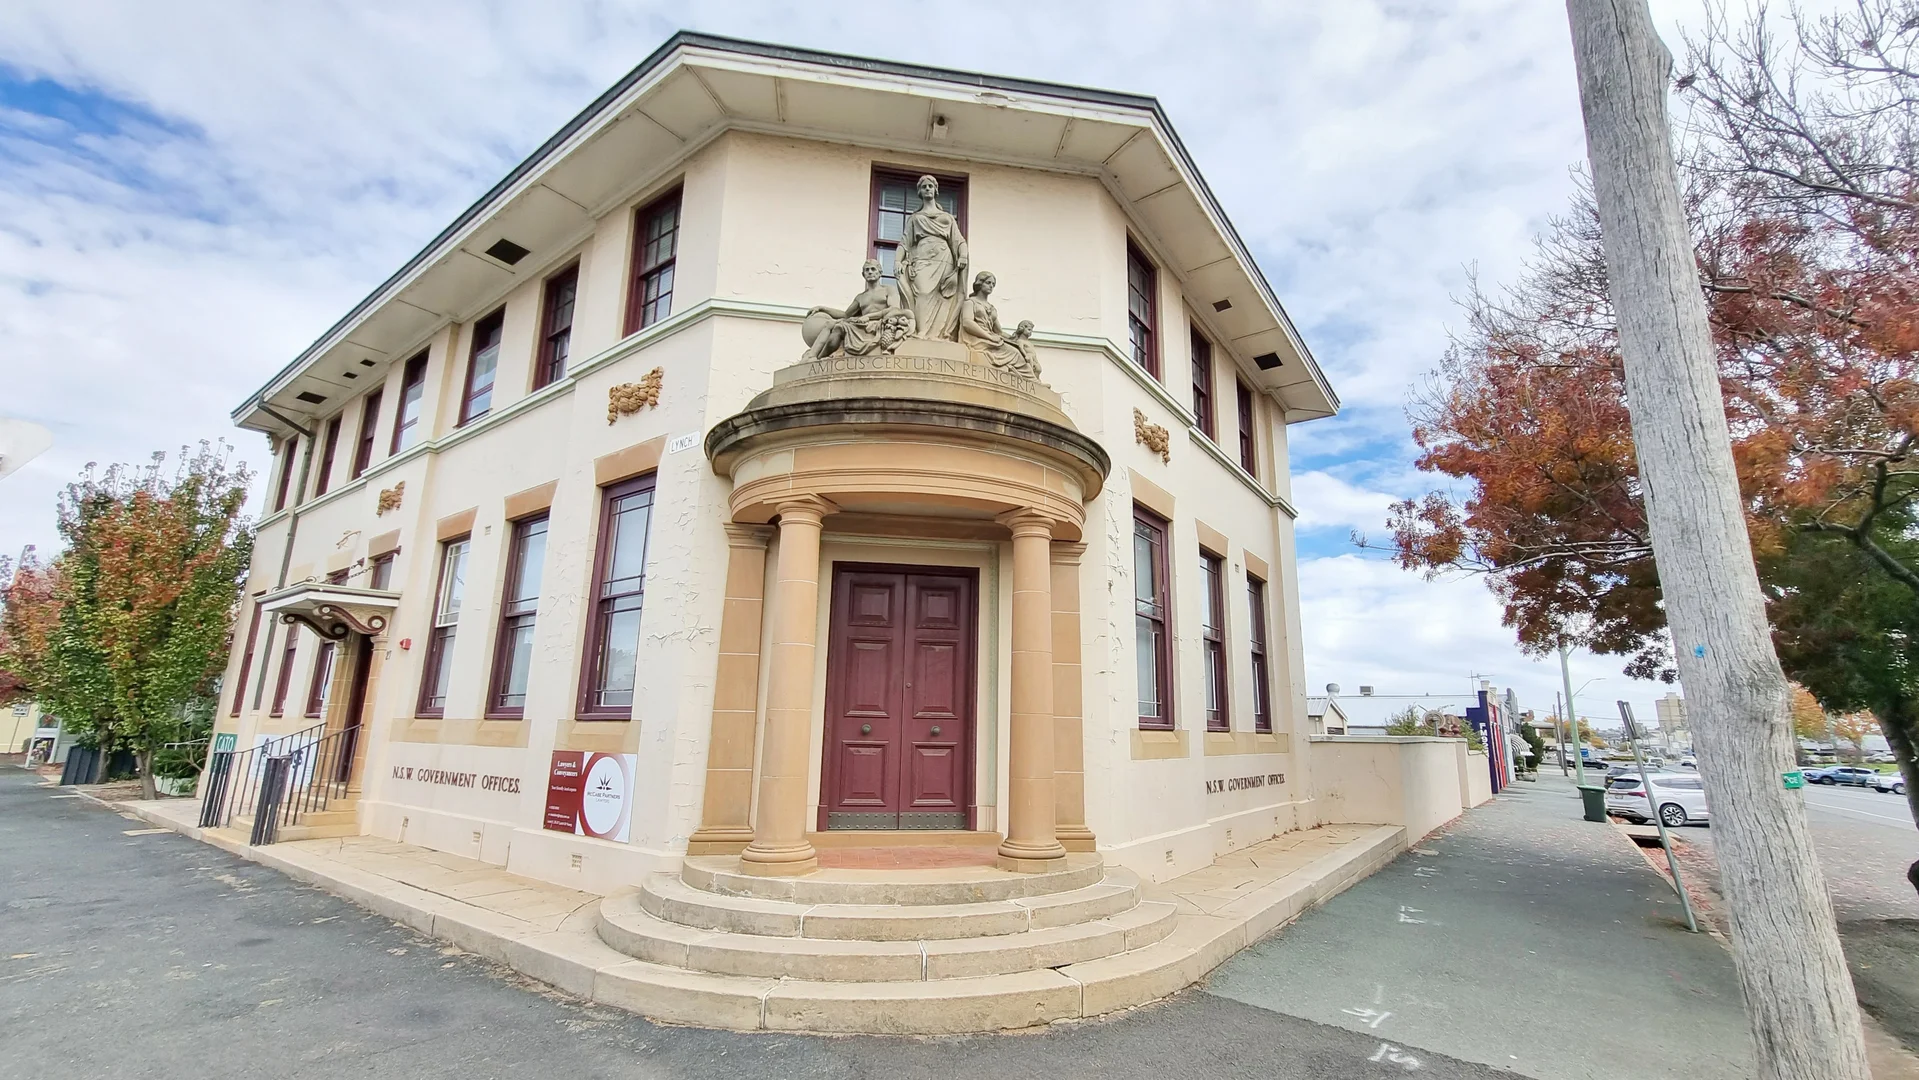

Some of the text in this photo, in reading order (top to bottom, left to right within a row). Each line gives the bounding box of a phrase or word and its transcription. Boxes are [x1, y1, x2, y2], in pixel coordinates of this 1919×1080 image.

[808, 357, 1036, 394] AMICUS CERTUS IN RE INCERTA
[671, 435, 693, 452] LYNCH
[216, 735, 234, 752] CATO
[392, 765, 521, 794] N.S.W. GOVERNMENT OFFICES.
[1228, 774, 1266, 792] GOVERNMENT
